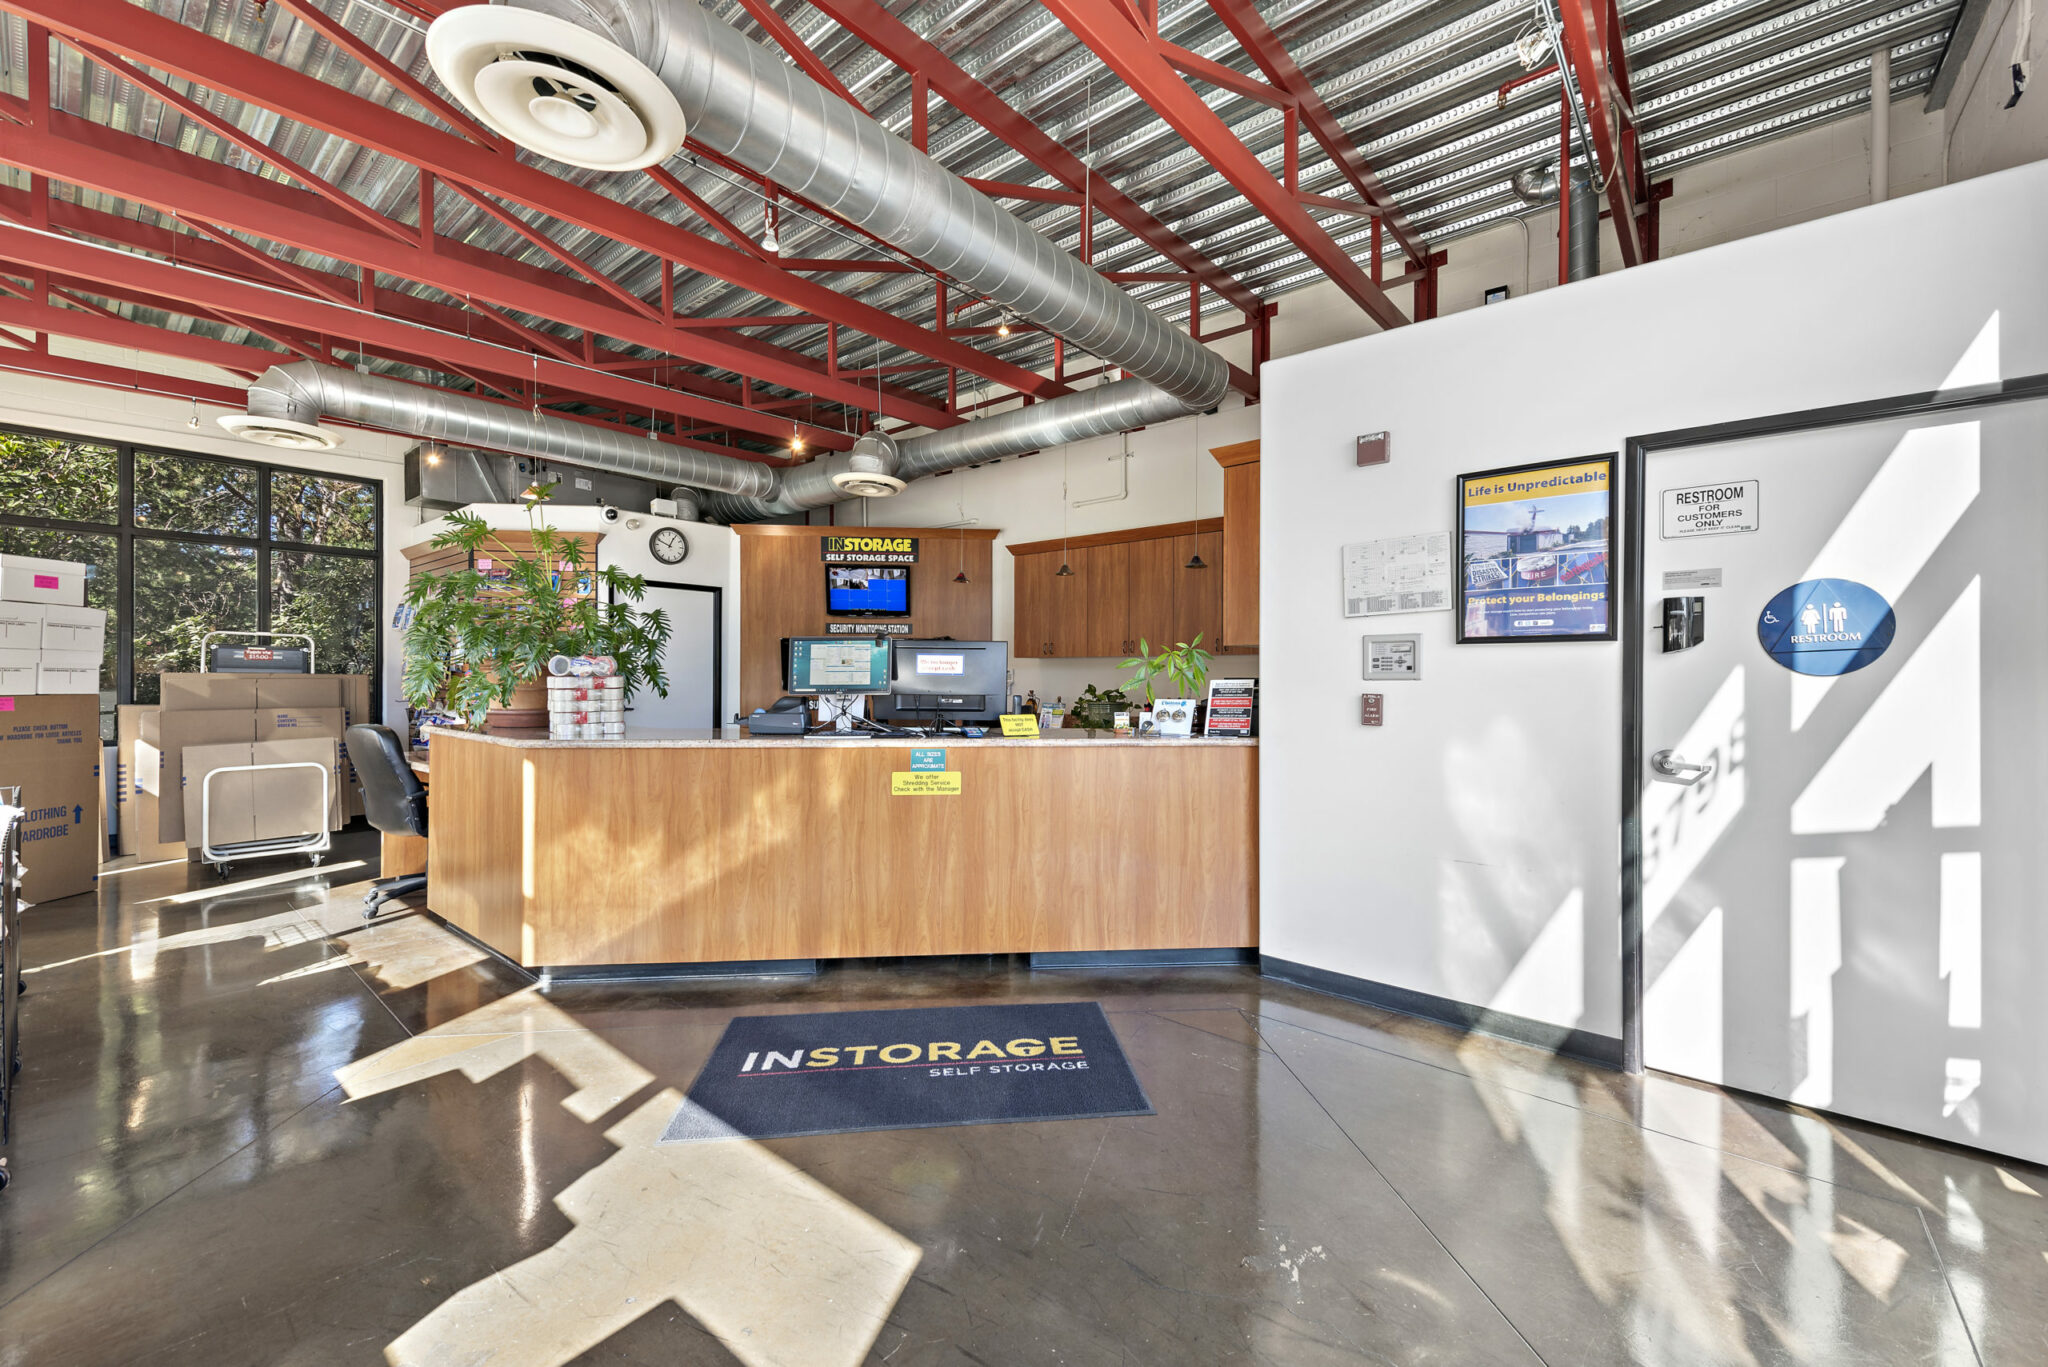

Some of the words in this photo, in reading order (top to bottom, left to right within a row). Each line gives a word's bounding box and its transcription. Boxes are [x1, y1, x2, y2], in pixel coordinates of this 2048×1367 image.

[1468, 486, 1491, 497] Life
[1494, 484, 1504, 494] is
[1507, 471, 1607, 492] Unpredictable
[1676, 486, 1744, 505] RESTROOM
[1698, 504, 1720, 512] FOR
[1677, 509, 1743, 522] CUSTOMERS
[1695, 519, 1723, 528] ONLY
[828, 537, 912, 552] INSTORAGE
[825, 553, 845, 561] SELF
[846, 554, 886, 562] STORAGE
[1472, 567, 1499, 576] DISASTER
[1468, 596, 1507, 605] Protect
[1509, 595, 1535, 605] your
[1537, 591, 1605, 603] Belongings
[829, 624, 855, 633] SECURITY
[887, 624, 909, 633] STATION
[1790, 632, 1862, 644] RESTROOM
[740, 1036, 1084, 1073] INSTORAGE
[929, 1066, 981, 1077] SELF
[989, 1061, 1090, 1075] STORAGE
